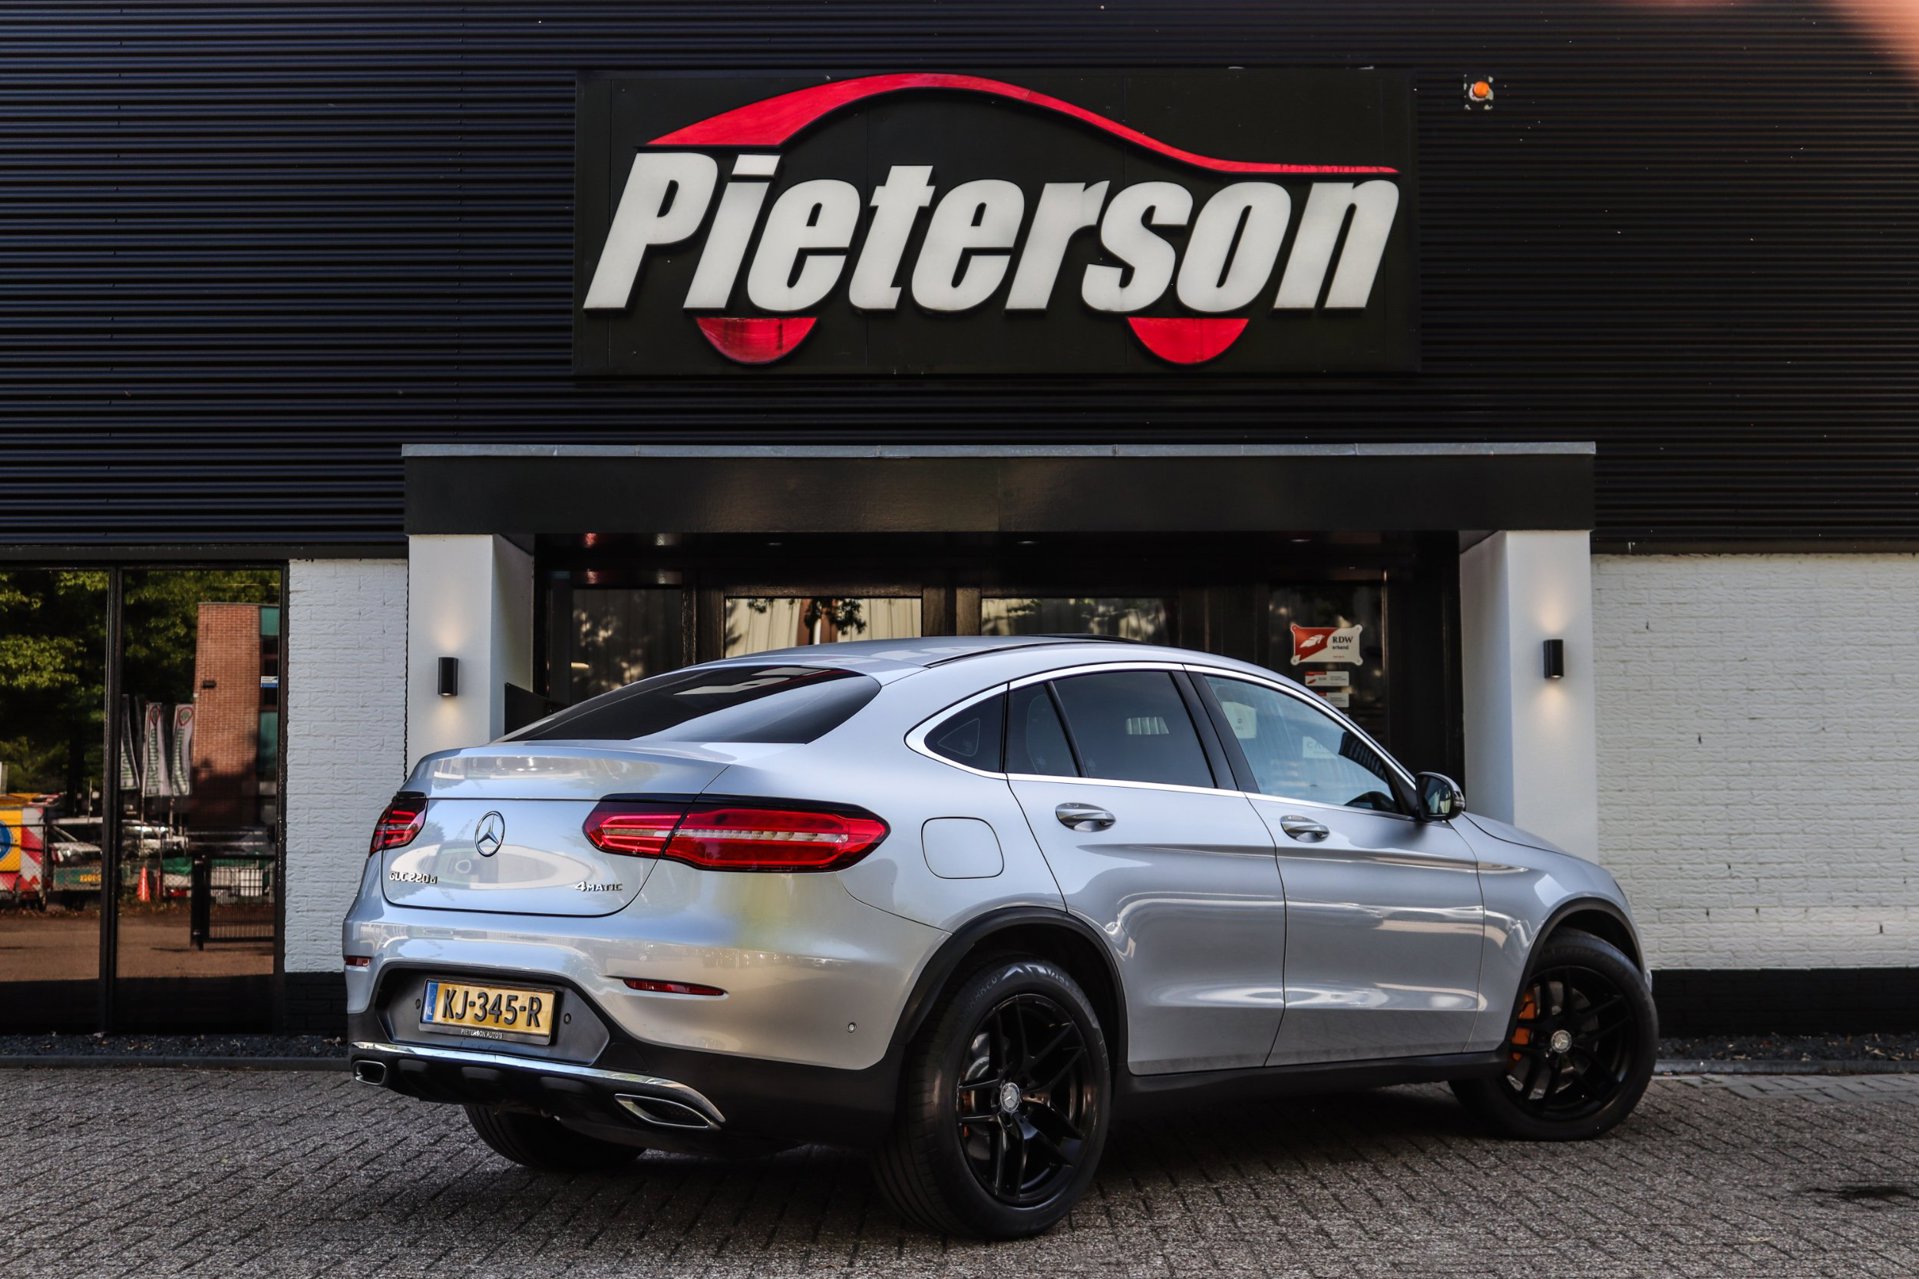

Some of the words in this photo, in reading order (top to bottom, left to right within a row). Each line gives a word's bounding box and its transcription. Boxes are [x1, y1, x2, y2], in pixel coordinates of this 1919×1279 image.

[584, 152, 1400, 313] Pieterson
[1332, 635, 1353, 644] RDW
[389, 871, 408, 882] GLC
[409, 872, 438, 884] 220d
[574, 880, 623, 892] 4MATIC
[442, 988, 543, 1028] KJ-345-R
